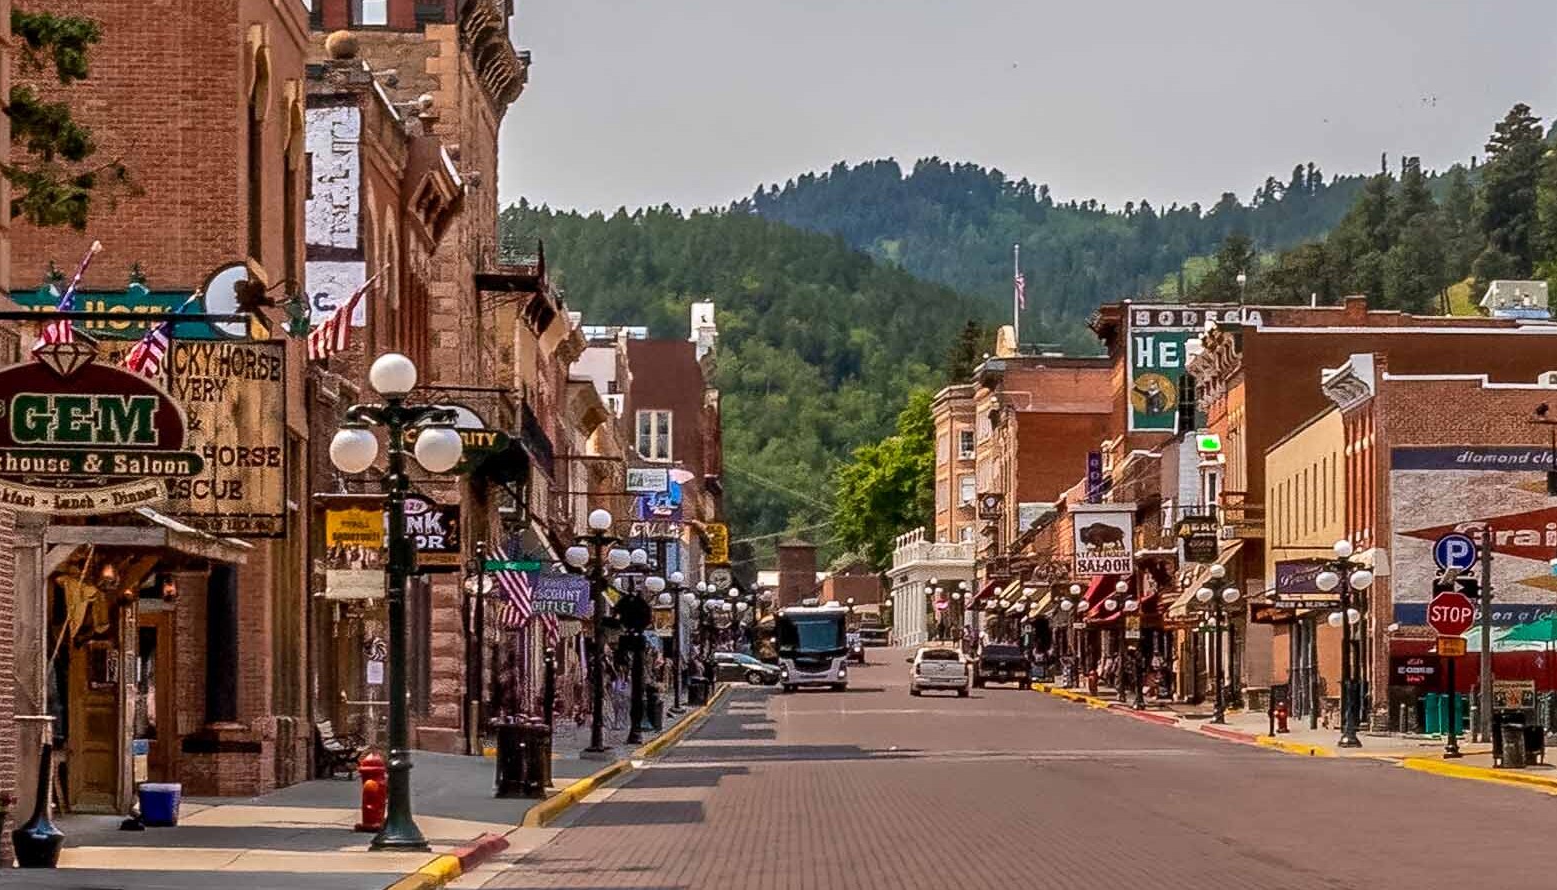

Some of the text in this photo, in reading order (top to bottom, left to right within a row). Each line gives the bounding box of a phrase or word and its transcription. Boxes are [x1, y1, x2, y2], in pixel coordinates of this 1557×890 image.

[219, 343, 282, 382] HORSE
[1135, 336, 1181, 369] HE
[10, 391, 160, 447] GEM
[83, 453, 103, 474] &
[113, 453, 191, 475] Saloon
[203, 446, 281, 468] HORSE
[1456, 450, 1529, 464] diamond
[1077, 559, 1131, 573] SALOON
[1431, 606, 1472, 623] STOP
